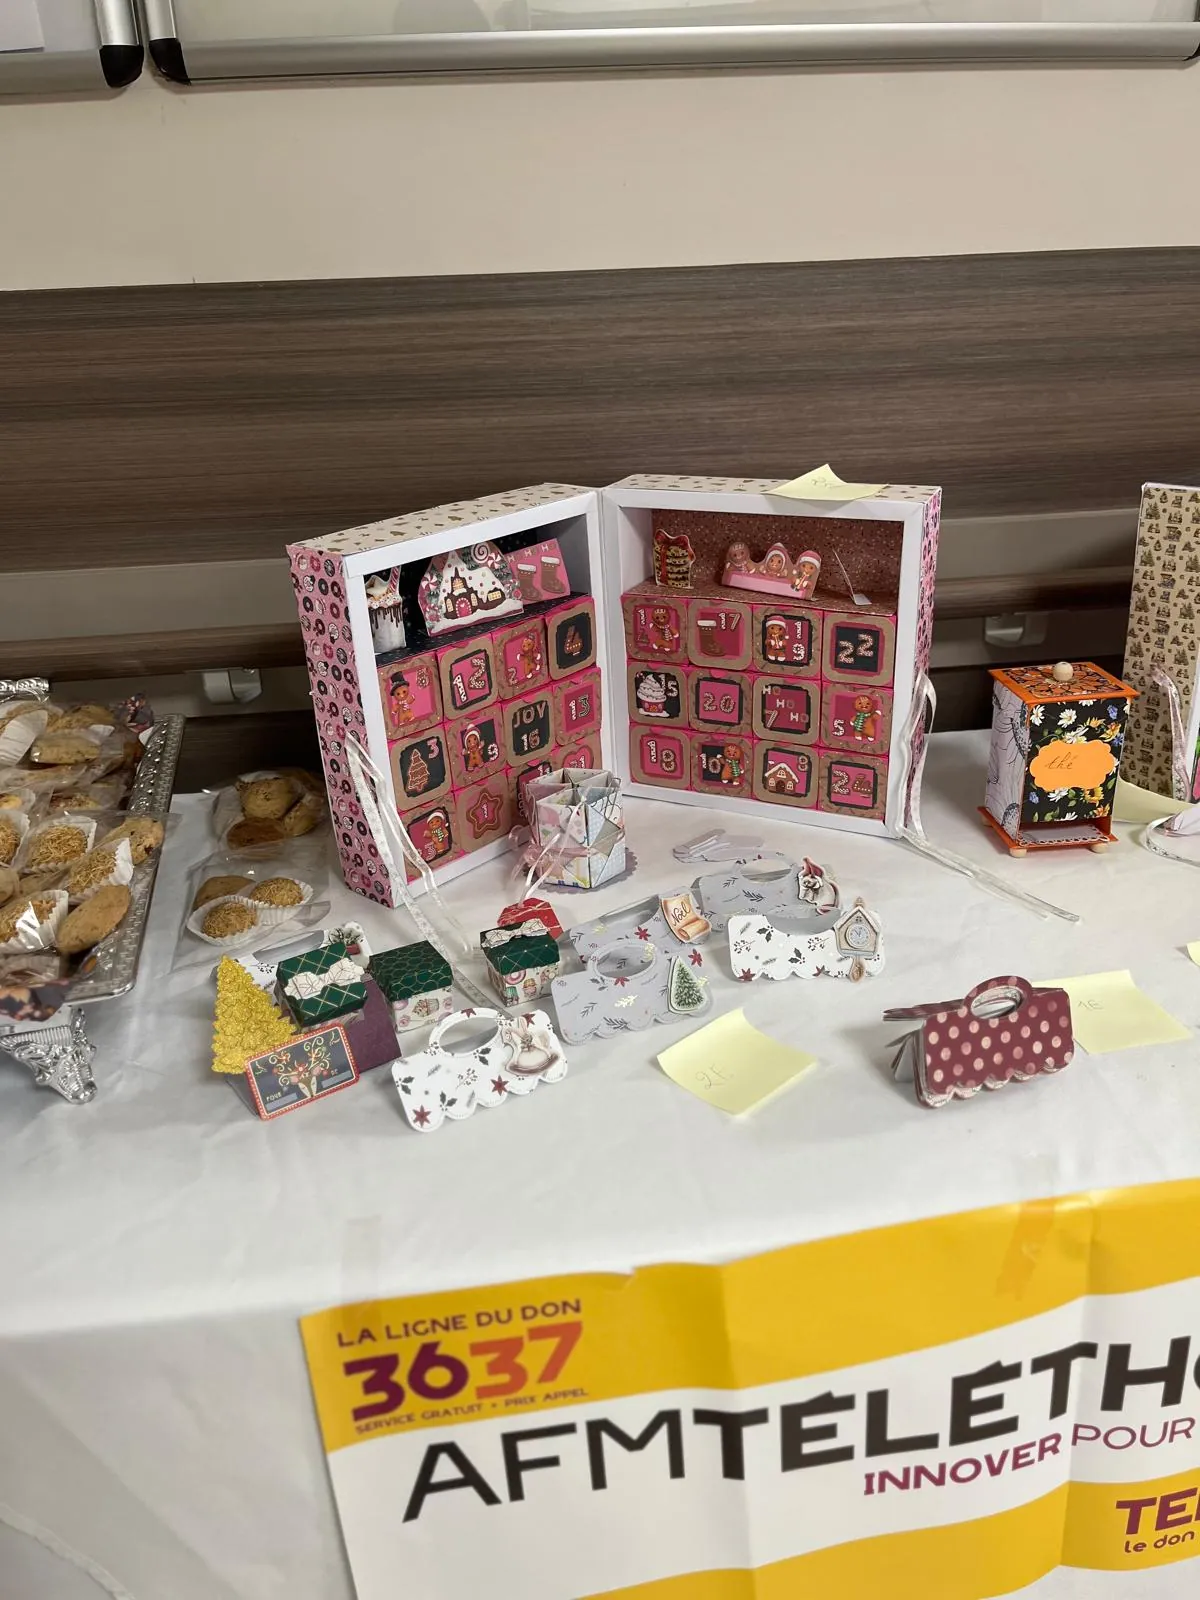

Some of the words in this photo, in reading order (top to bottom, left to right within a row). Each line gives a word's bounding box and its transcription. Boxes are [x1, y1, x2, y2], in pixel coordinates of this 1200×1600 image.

[719, 612, 742, 631] 17
[837, 633, 875, 665] 22
[452, 657, 487, 702] 12
[513, 701, 546, 729] JOY
[702, 692, 737, 714] 20
[764, 709, 779, 728] 7
[832, 718, 846, 738] 5
[427, 738, 441, 760] 3
[646, 740, 678, 773] 18
[336, 1327, 377, 1348] LA
[385, 1315, 467, 1340] LIGNE
[475, 1309, 513, 1328] DU
[520, 1299, 582, 1321] DON
[342, 1320, 583, 1422] 3637
[354, 1413, 416, 1435] SERVICE
[421, 1403, 484, 1421] GRATUIT
[504, 1396, 537, 1408] PRIX
[543, 1388, 589, 1403] APPEL
[402, 1335, 1200, 1523] AFMTÉLÉTH
[863, 1432, 1063, 1496] INNOVER
[1071, 1416, 1197, 1450] POUR
[1115, 1487, 1200, 1536] TE
[1124, 1540, 1148, 1554] le
[1153, 1530, 1196, 1550] don
